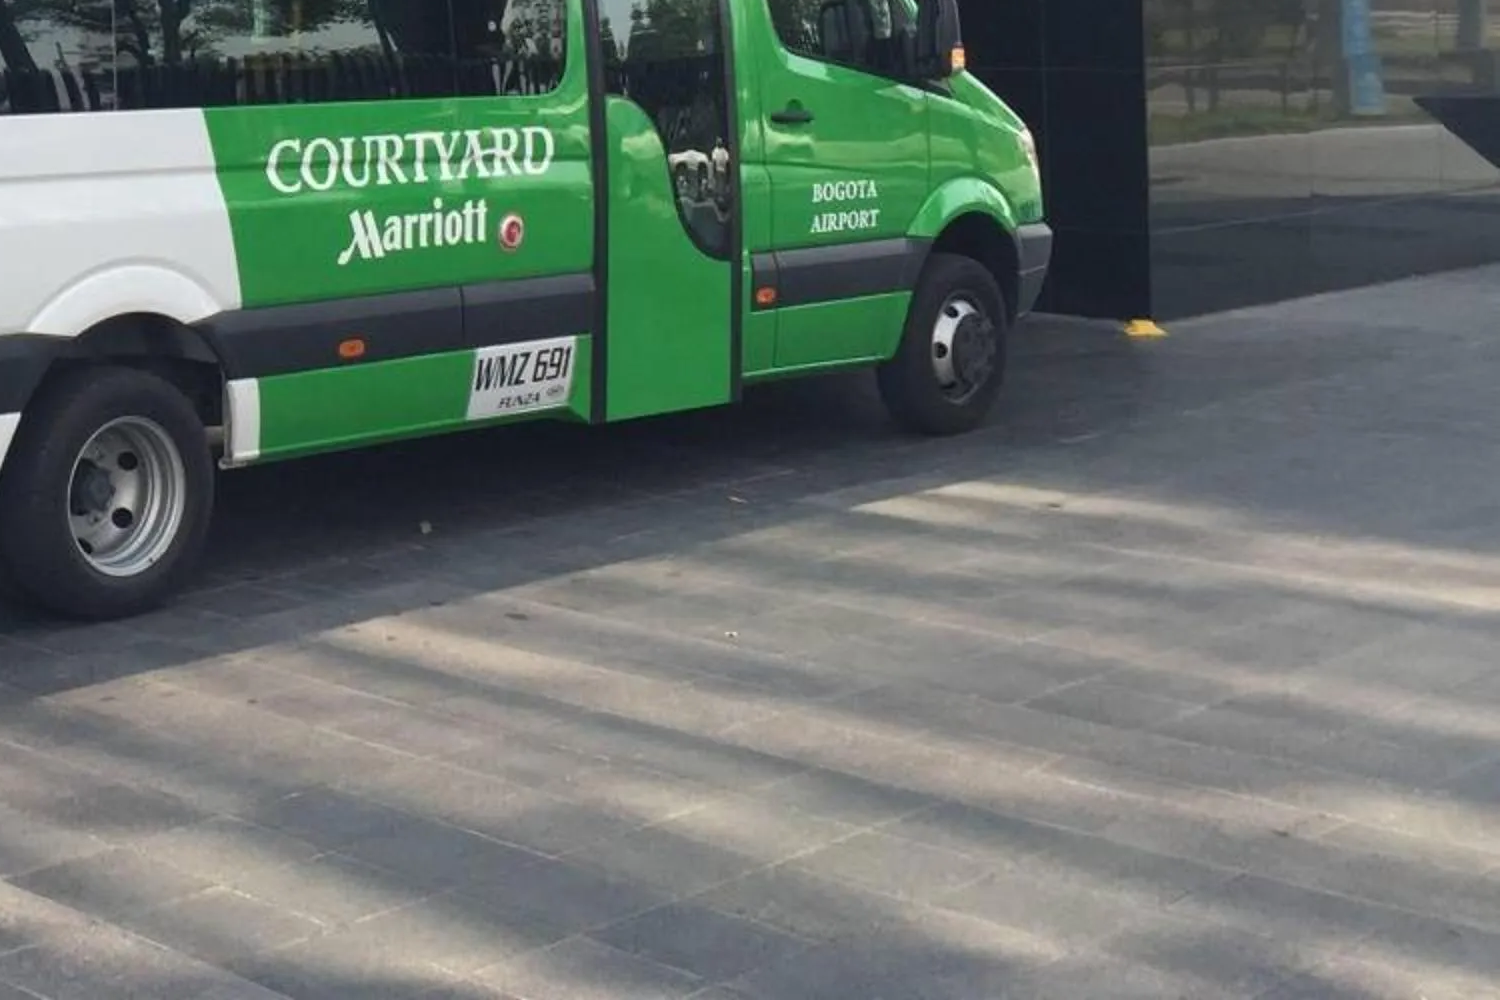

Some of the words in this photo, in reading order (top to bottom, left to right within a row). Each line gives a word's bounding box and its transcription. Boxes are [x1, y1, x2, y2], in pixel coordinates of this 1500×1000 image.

[266, 126, 555, 193] COURTYARD
[811, 179, 878, 203] BOGOTA
[337, 197, 488, 265] Marriott
[810, 208, 881, 234] AIRPORT
[475, 351, 533, 392] WMZ
[532, 346, 572, 383] 691
